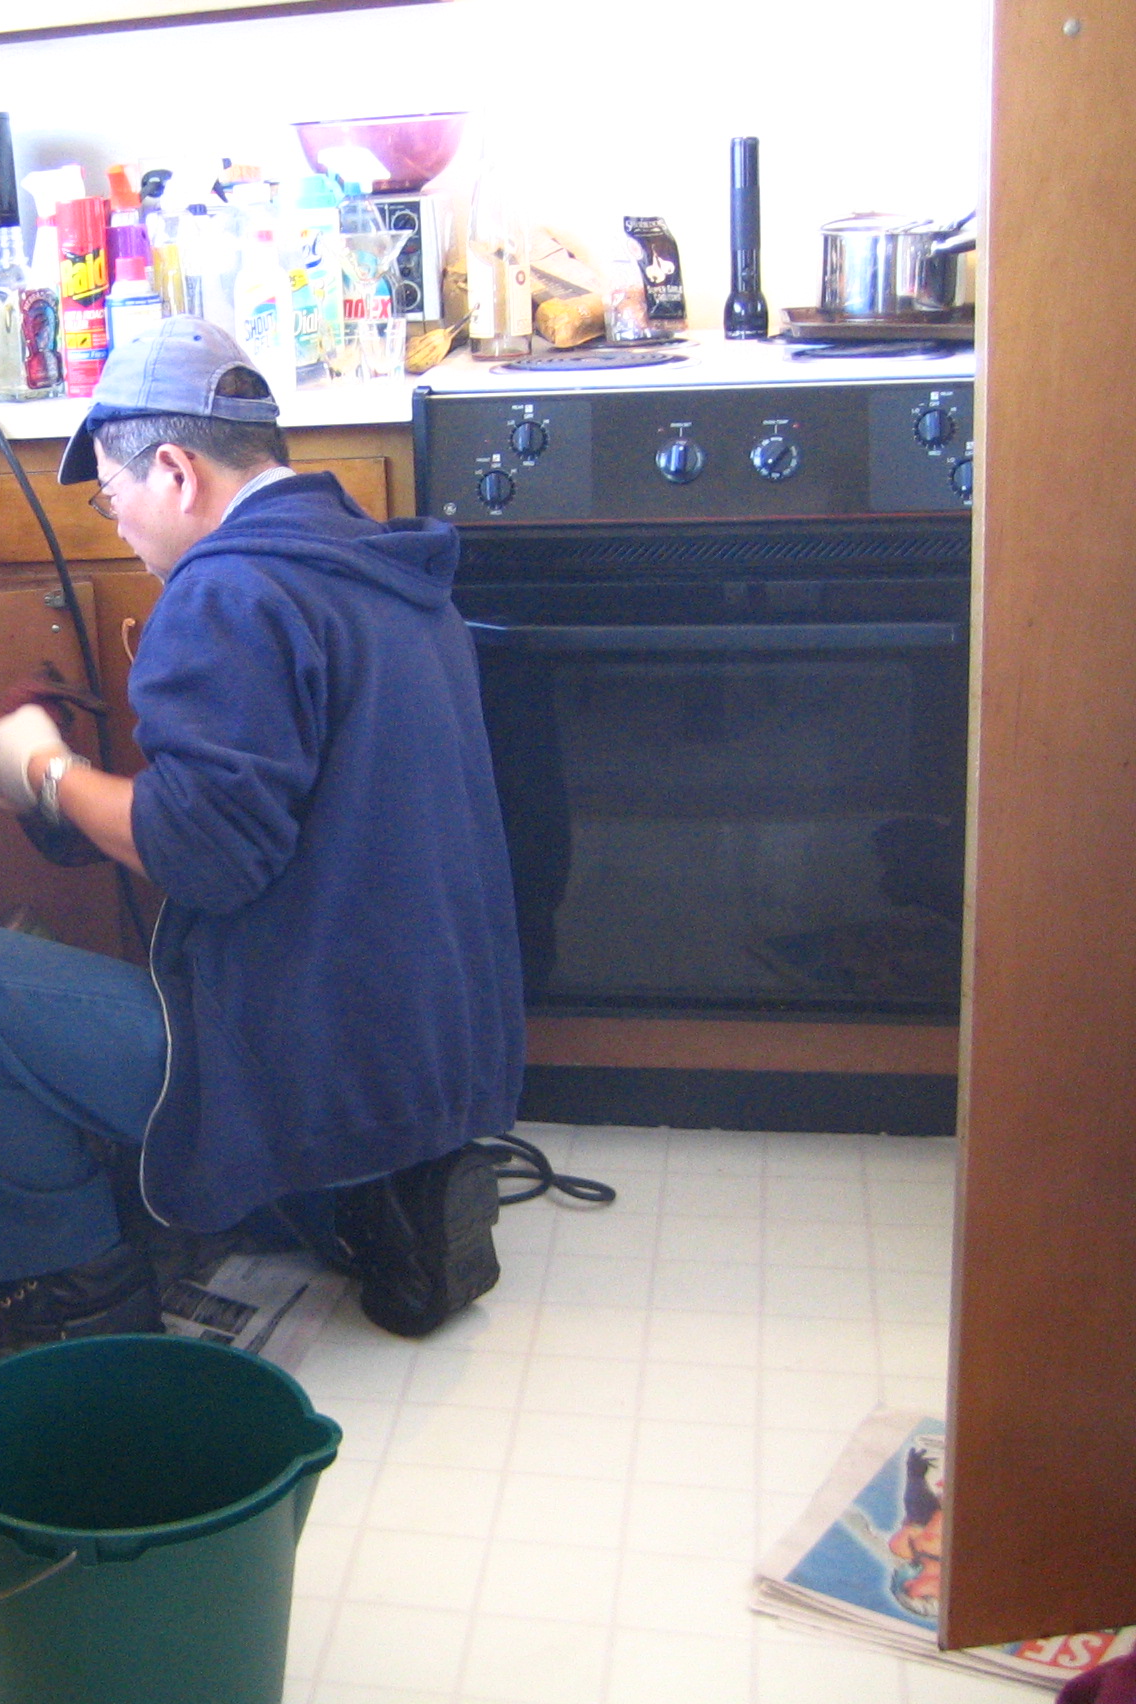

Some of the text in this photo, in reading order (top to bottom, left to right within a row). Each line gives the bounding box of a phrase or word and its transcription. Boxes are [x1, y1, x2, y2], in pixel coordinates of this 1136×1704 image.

[60, 249, 108, 298] Raid
[244, 311, 275, 341] SHOUT
[293, 306, 320, 337] Dial
